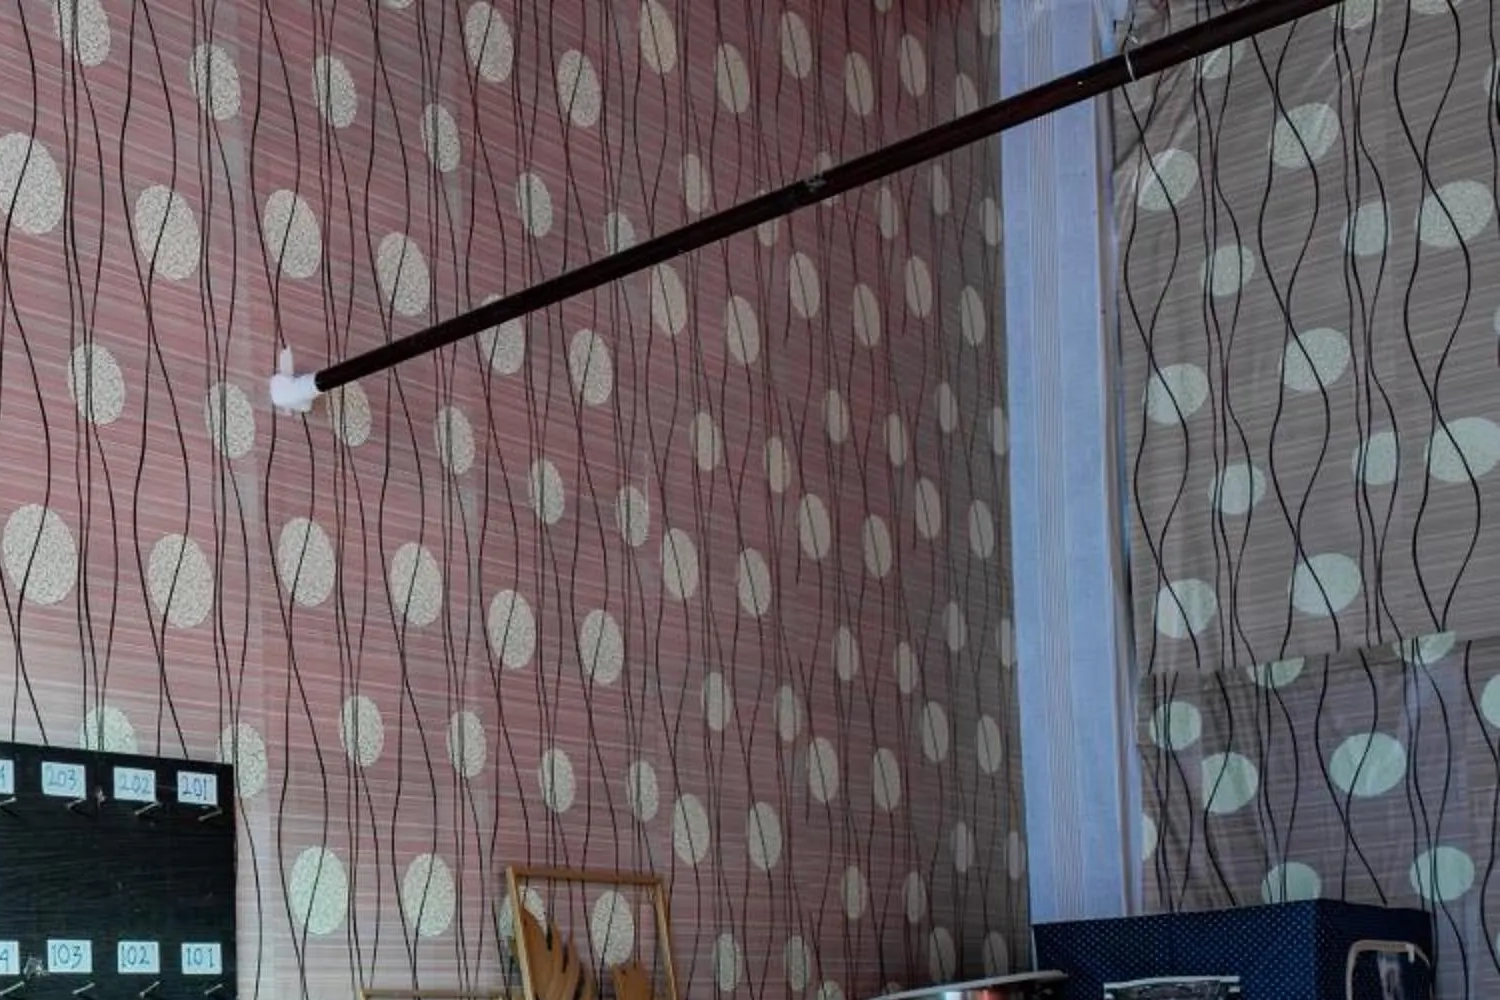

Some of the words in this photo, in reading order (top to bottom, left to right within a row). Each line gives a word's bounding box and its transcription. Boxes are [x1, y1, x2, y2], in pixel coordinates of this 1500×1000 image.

[47, 768, 78, 791] 203
[119, 773, 151, 794] 202
[182, 775, 208, 800] 201
[51, 943, 83, 969] 103
[120, 944, 150, 968] 102
[186, 947, 215, 969] 101
